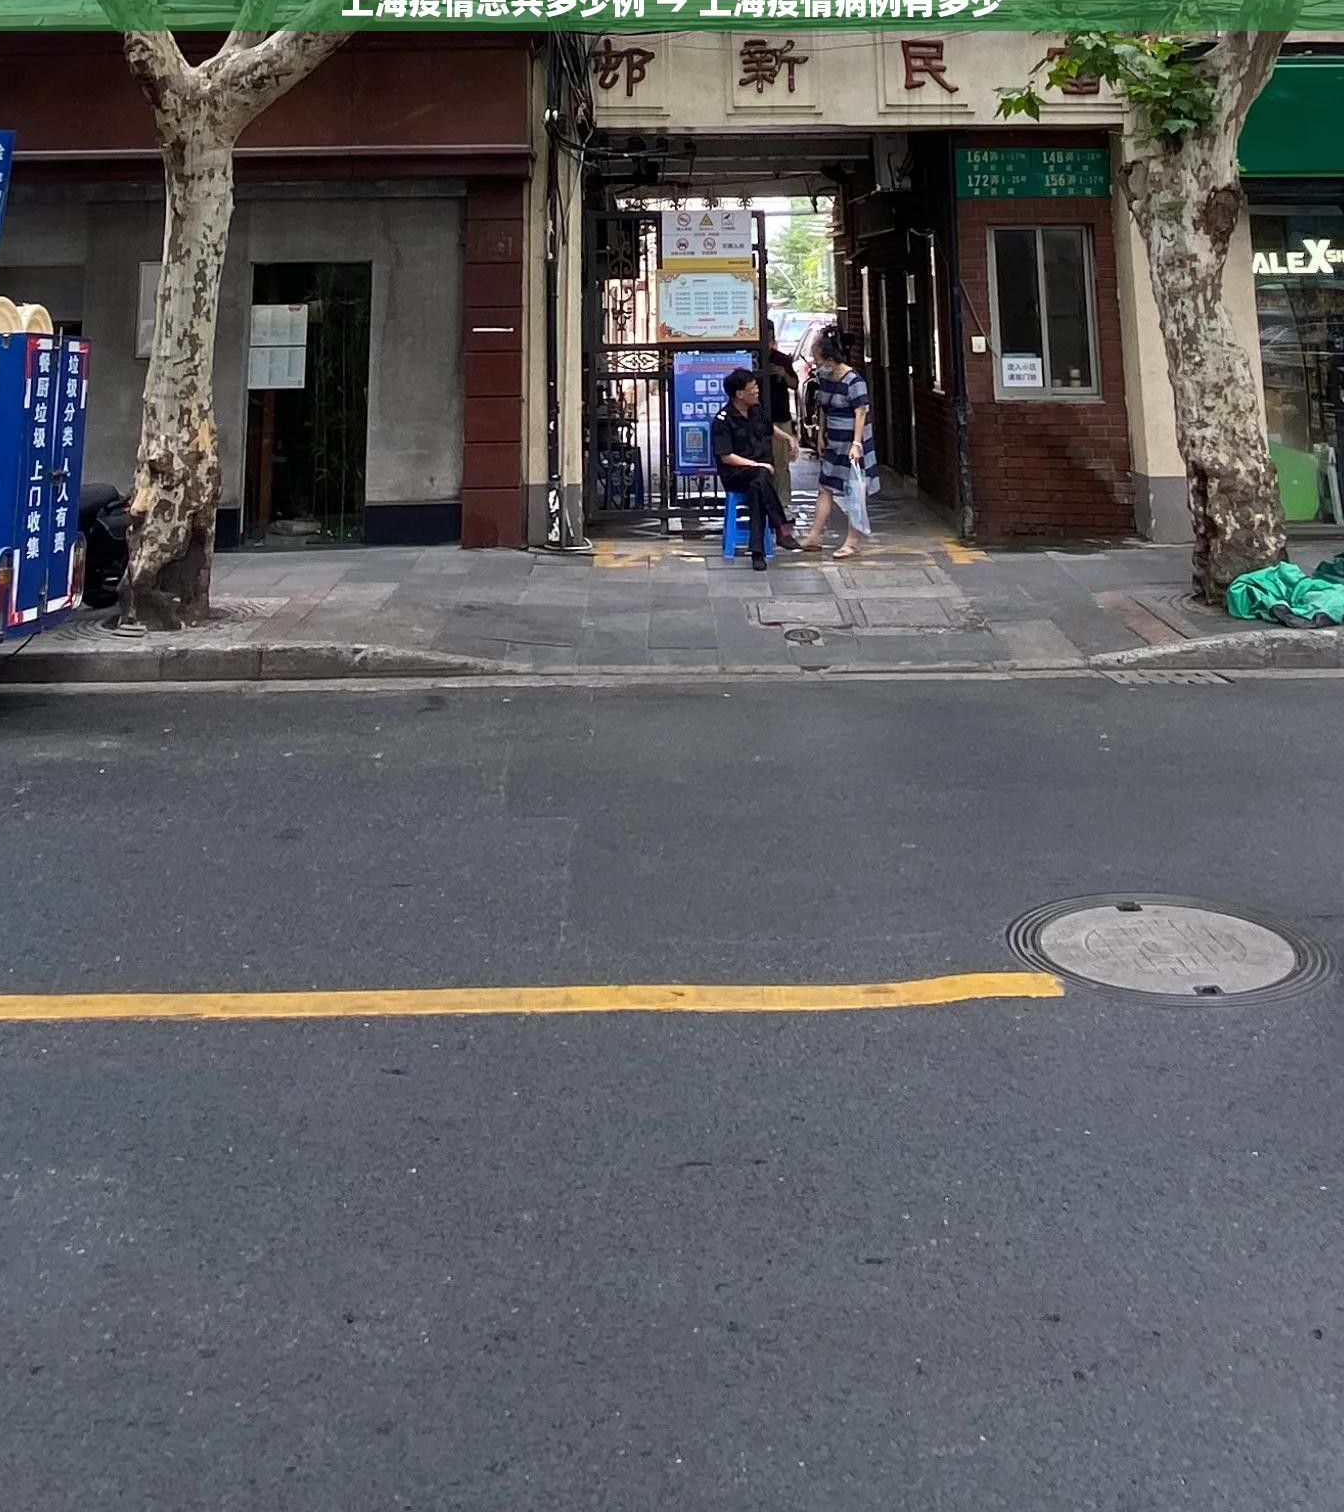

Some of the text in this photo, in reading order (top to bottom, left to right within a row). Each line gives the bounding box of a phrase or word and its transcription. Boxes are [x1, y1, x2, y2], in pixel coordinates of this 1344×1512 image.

[1252, 238, 1334, 274] ALEX
[26, 352, 51, 560] 餐厨垃圾 上门收集
[53, 354, 80, 554] 垃圾分类 人人有责
